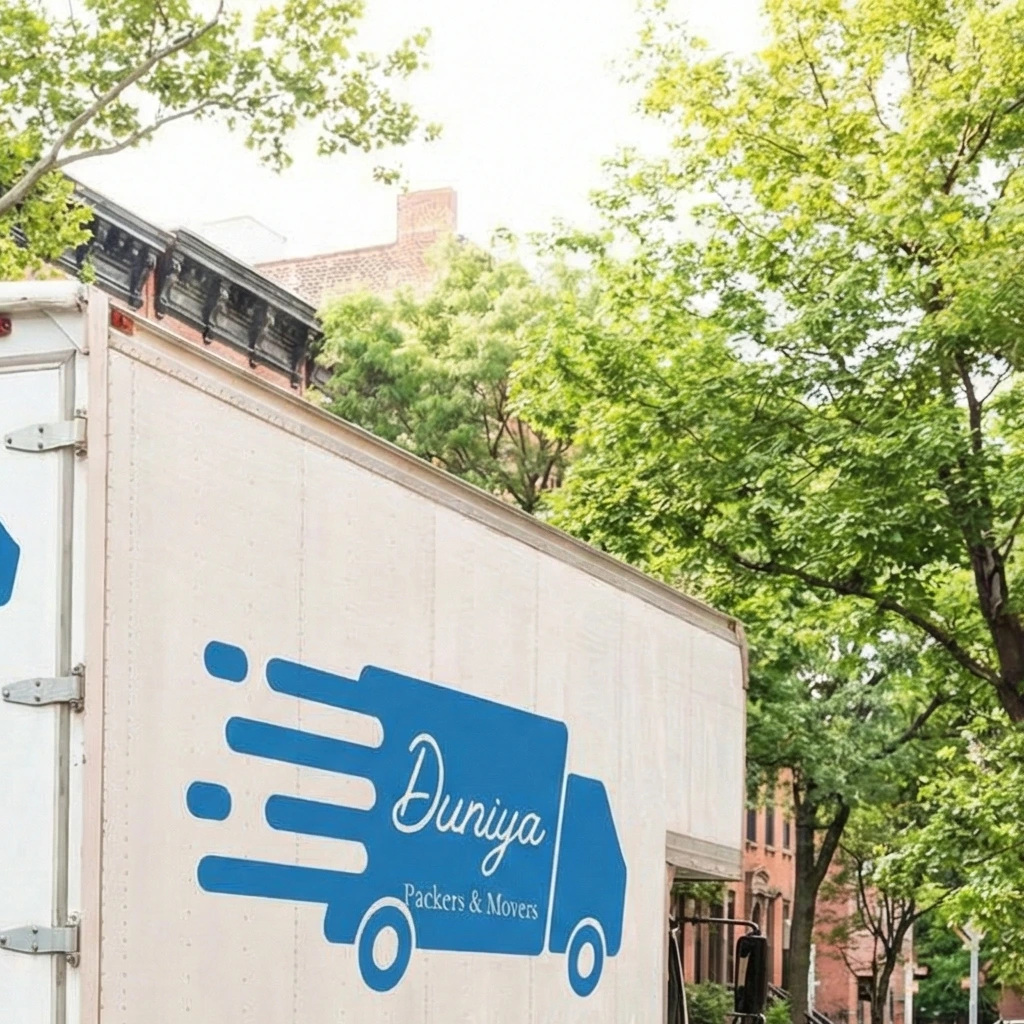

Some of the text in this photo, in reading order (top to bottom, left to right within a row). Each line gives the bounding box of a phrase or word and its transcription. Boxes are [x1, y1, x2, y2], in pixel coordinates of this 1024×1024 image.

[392, 733, 546, 876] Duniya
[404, 883, 538, 920] Packers & Movers
